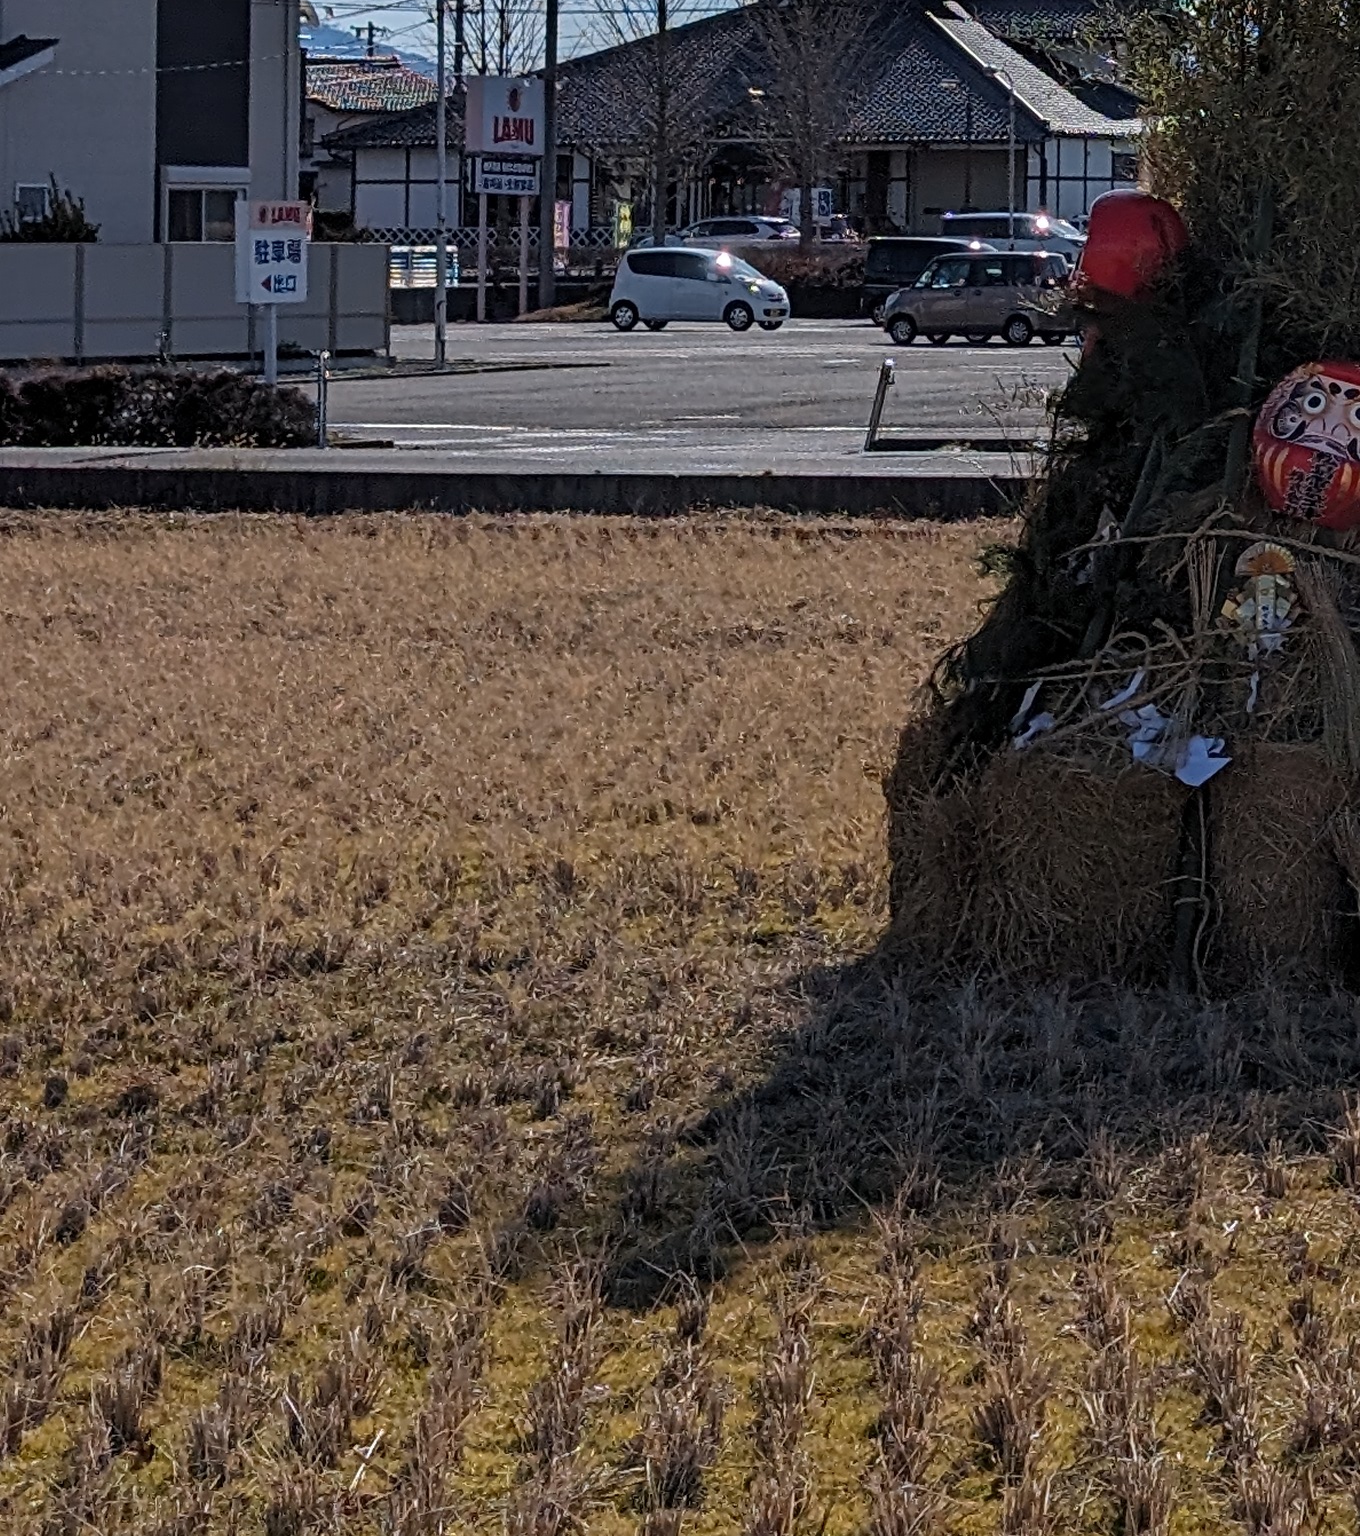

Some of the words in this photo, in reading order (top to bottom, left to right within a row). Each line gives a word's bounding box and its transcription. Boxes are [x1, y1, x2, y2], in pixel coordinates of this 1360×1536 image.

[493, 116, 534, 145] LAMU
[255, 239, 301, 265] 駐車場
